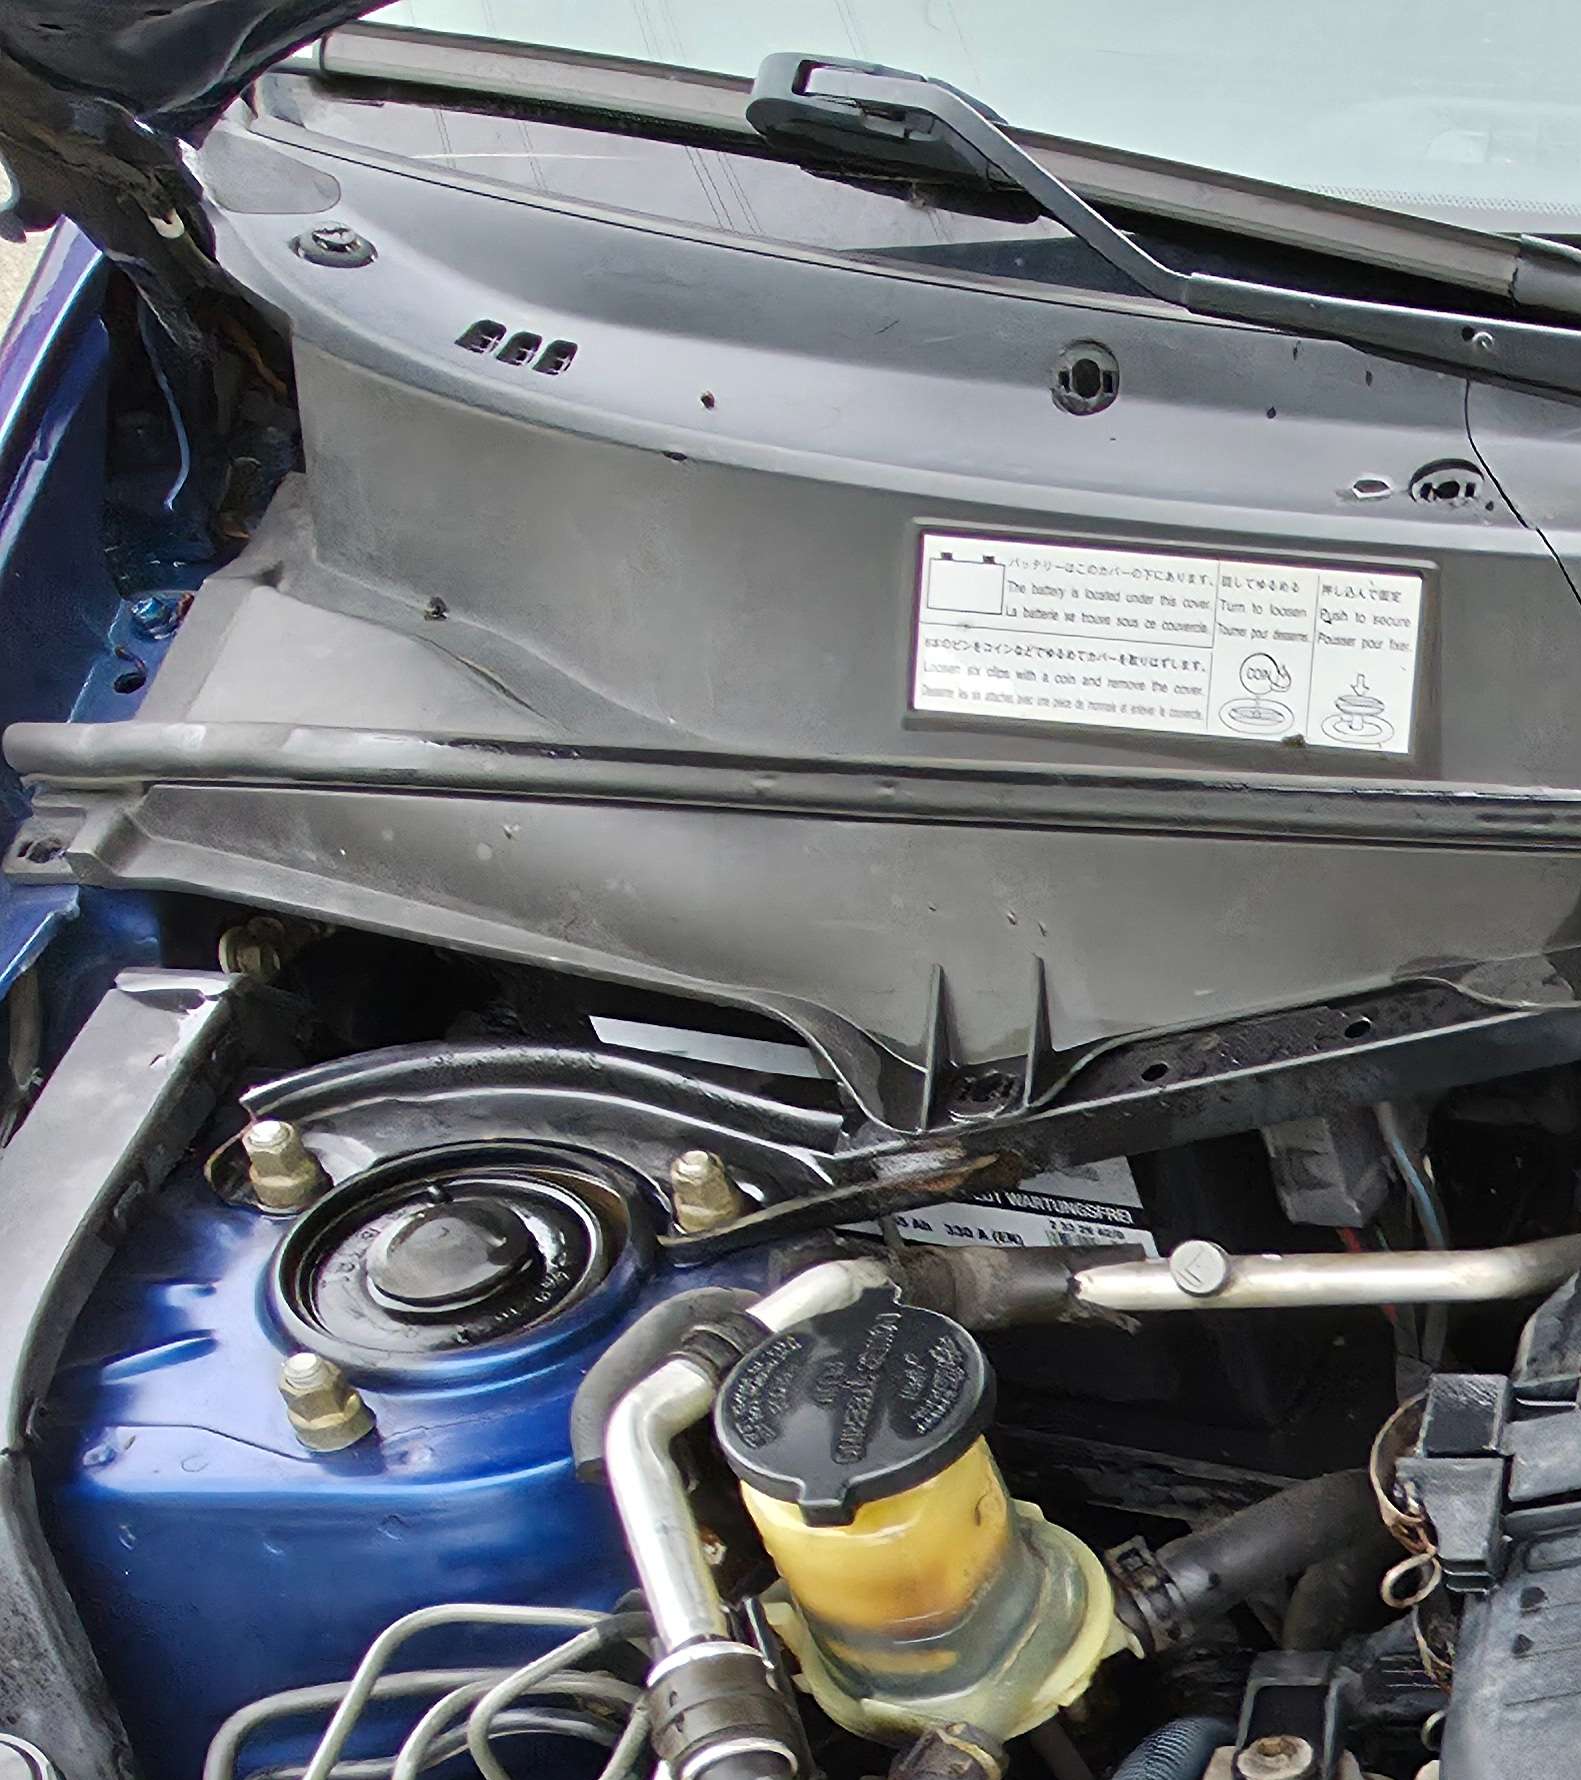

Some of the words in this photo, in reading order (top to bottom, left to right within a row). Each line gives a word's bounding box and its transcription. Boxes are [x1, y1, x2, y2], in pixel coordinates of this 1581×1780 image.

[1031, 583, 1064, 600] battery
[1126, 594, 1154, 605] under
[1160, 595, 1177, 607] this
[1219, 598, 1246, 613] Turn
[1252, 603, 1263, 615] to
[1320, 608, 1349, 625] Push
[1355, 612, 1367, 624] to
[986, 666, 1010, 679] clips
[1016, 669, 1036, 681] with
[1054, 674, 1077, 685] coin
[1082, 676, 1102, 688] and
[1107, 679, 1145, 691] remove
[1151, 682, 1168, 693] the
